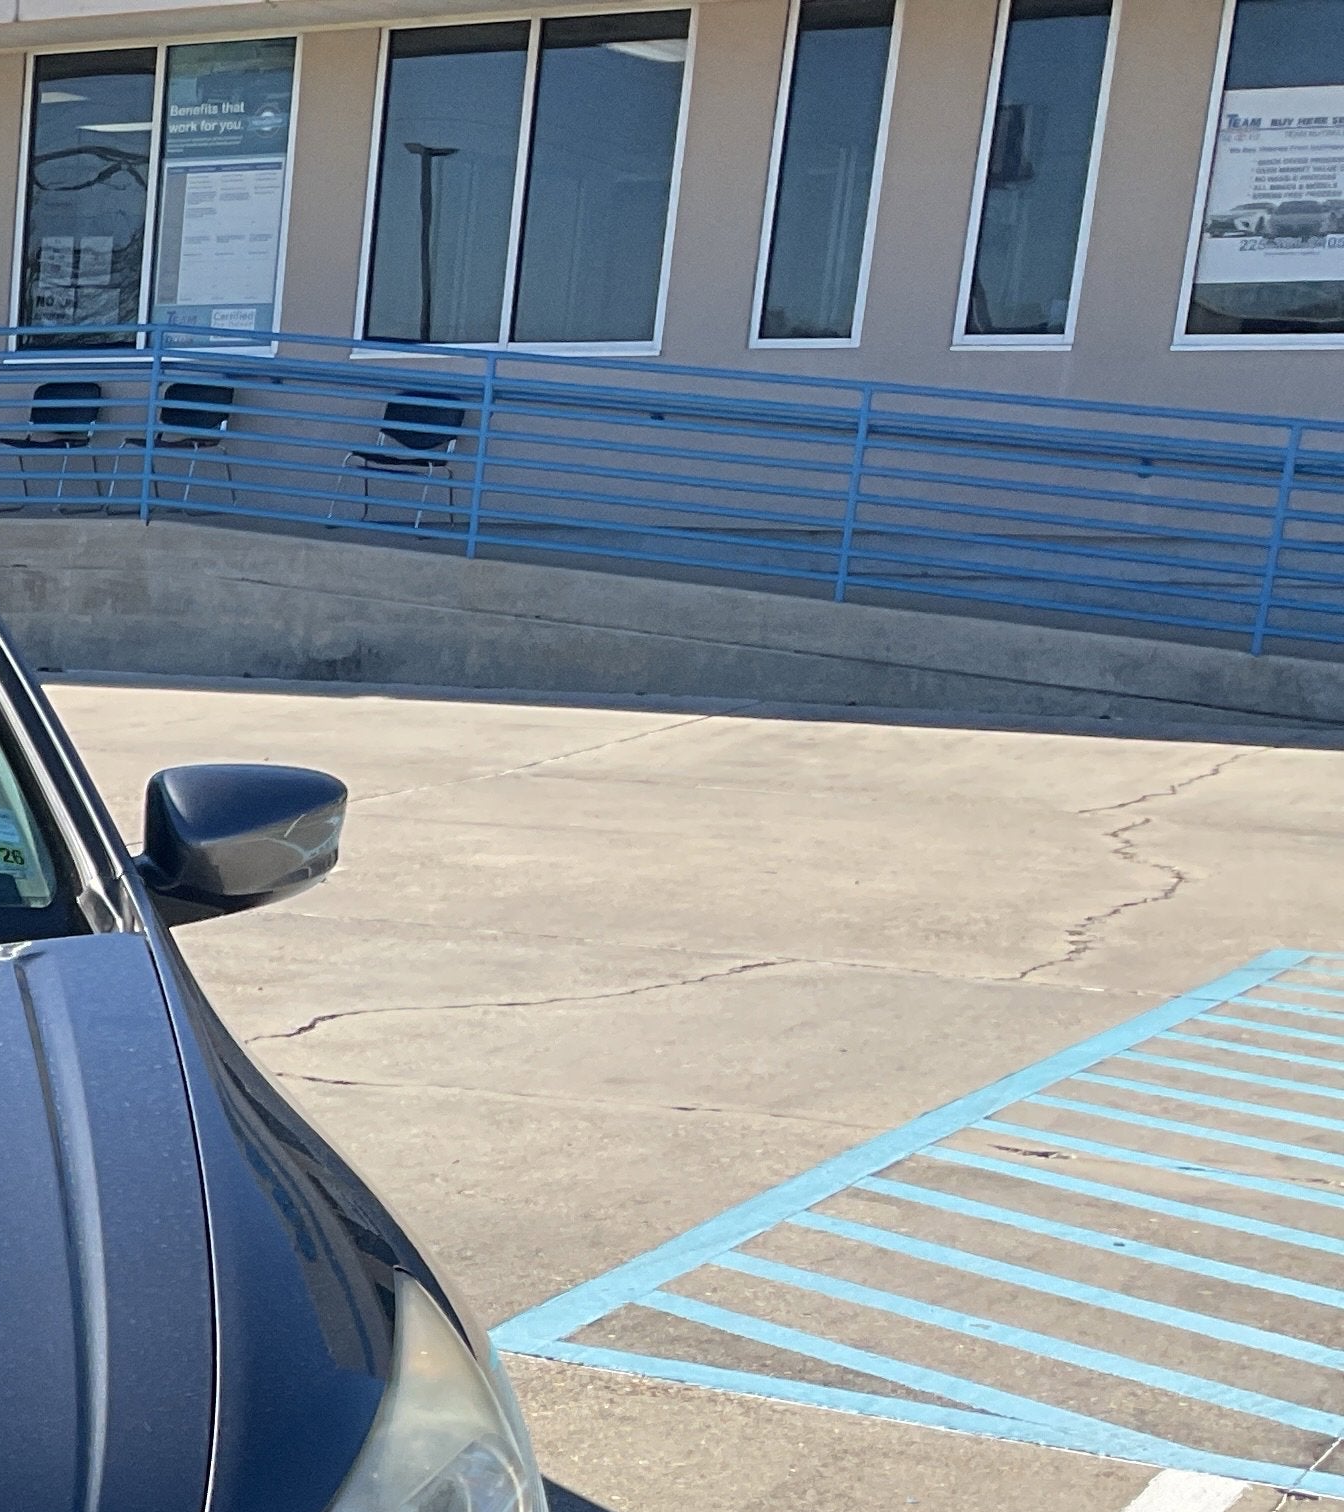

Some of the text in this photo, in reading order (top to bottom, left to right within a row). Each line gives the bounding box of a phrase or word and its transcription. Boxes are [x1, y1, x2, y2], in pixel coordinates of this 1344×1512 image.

[170, 101, 245, 117] Benefits that
[168, 120, 198, 134] work
[200, 119, 218, 132] for
[1226, 113, 1262, 129] TEAM
[1270, 118, 1295, 127] BUY
[0, 846, 25, 866] 26
